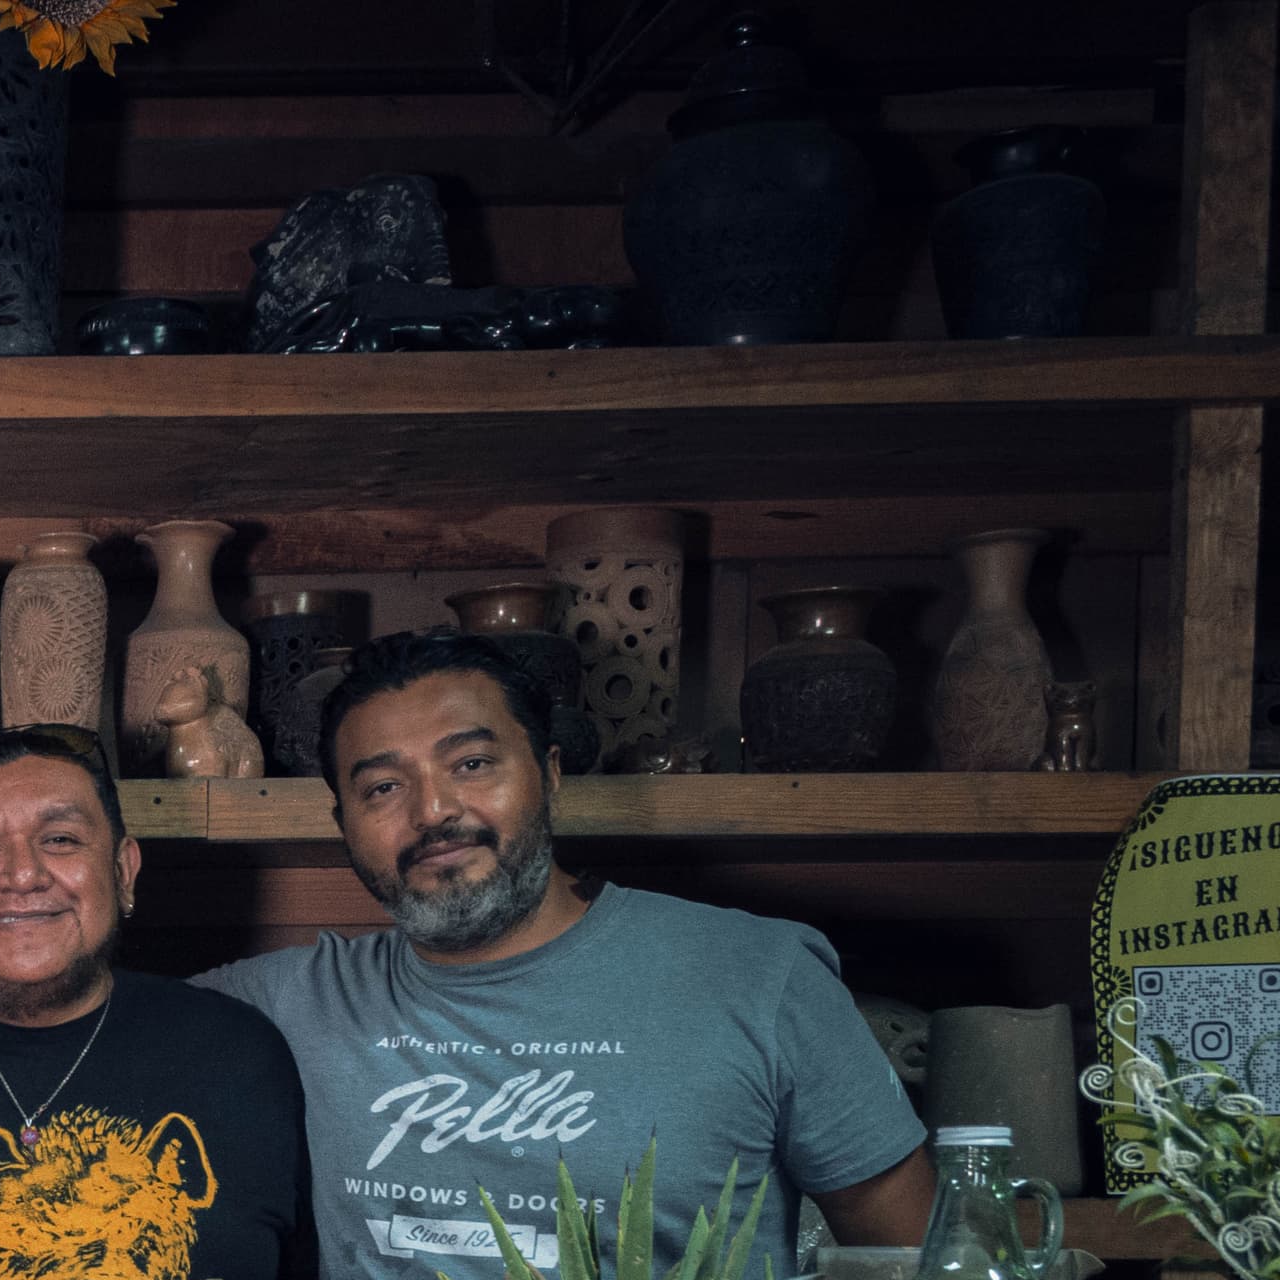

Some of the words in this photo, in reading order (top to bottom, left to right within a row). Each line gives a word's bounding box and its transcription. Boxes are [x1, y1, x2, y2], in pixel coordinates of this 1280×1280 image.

[1196, 875, 1238, 907] EN
[1119, 906, 1280, 955] INSTAGRA
[376, 1035, 486, 1055] AUTHENTIC
[511, 1041, 625, 1056] ORIGINAL
[366, 1069, 597, 1170] Pella
[344, 1177, 468, 1206] WINDOWS
[406, 1225, 458, 1246] Since
